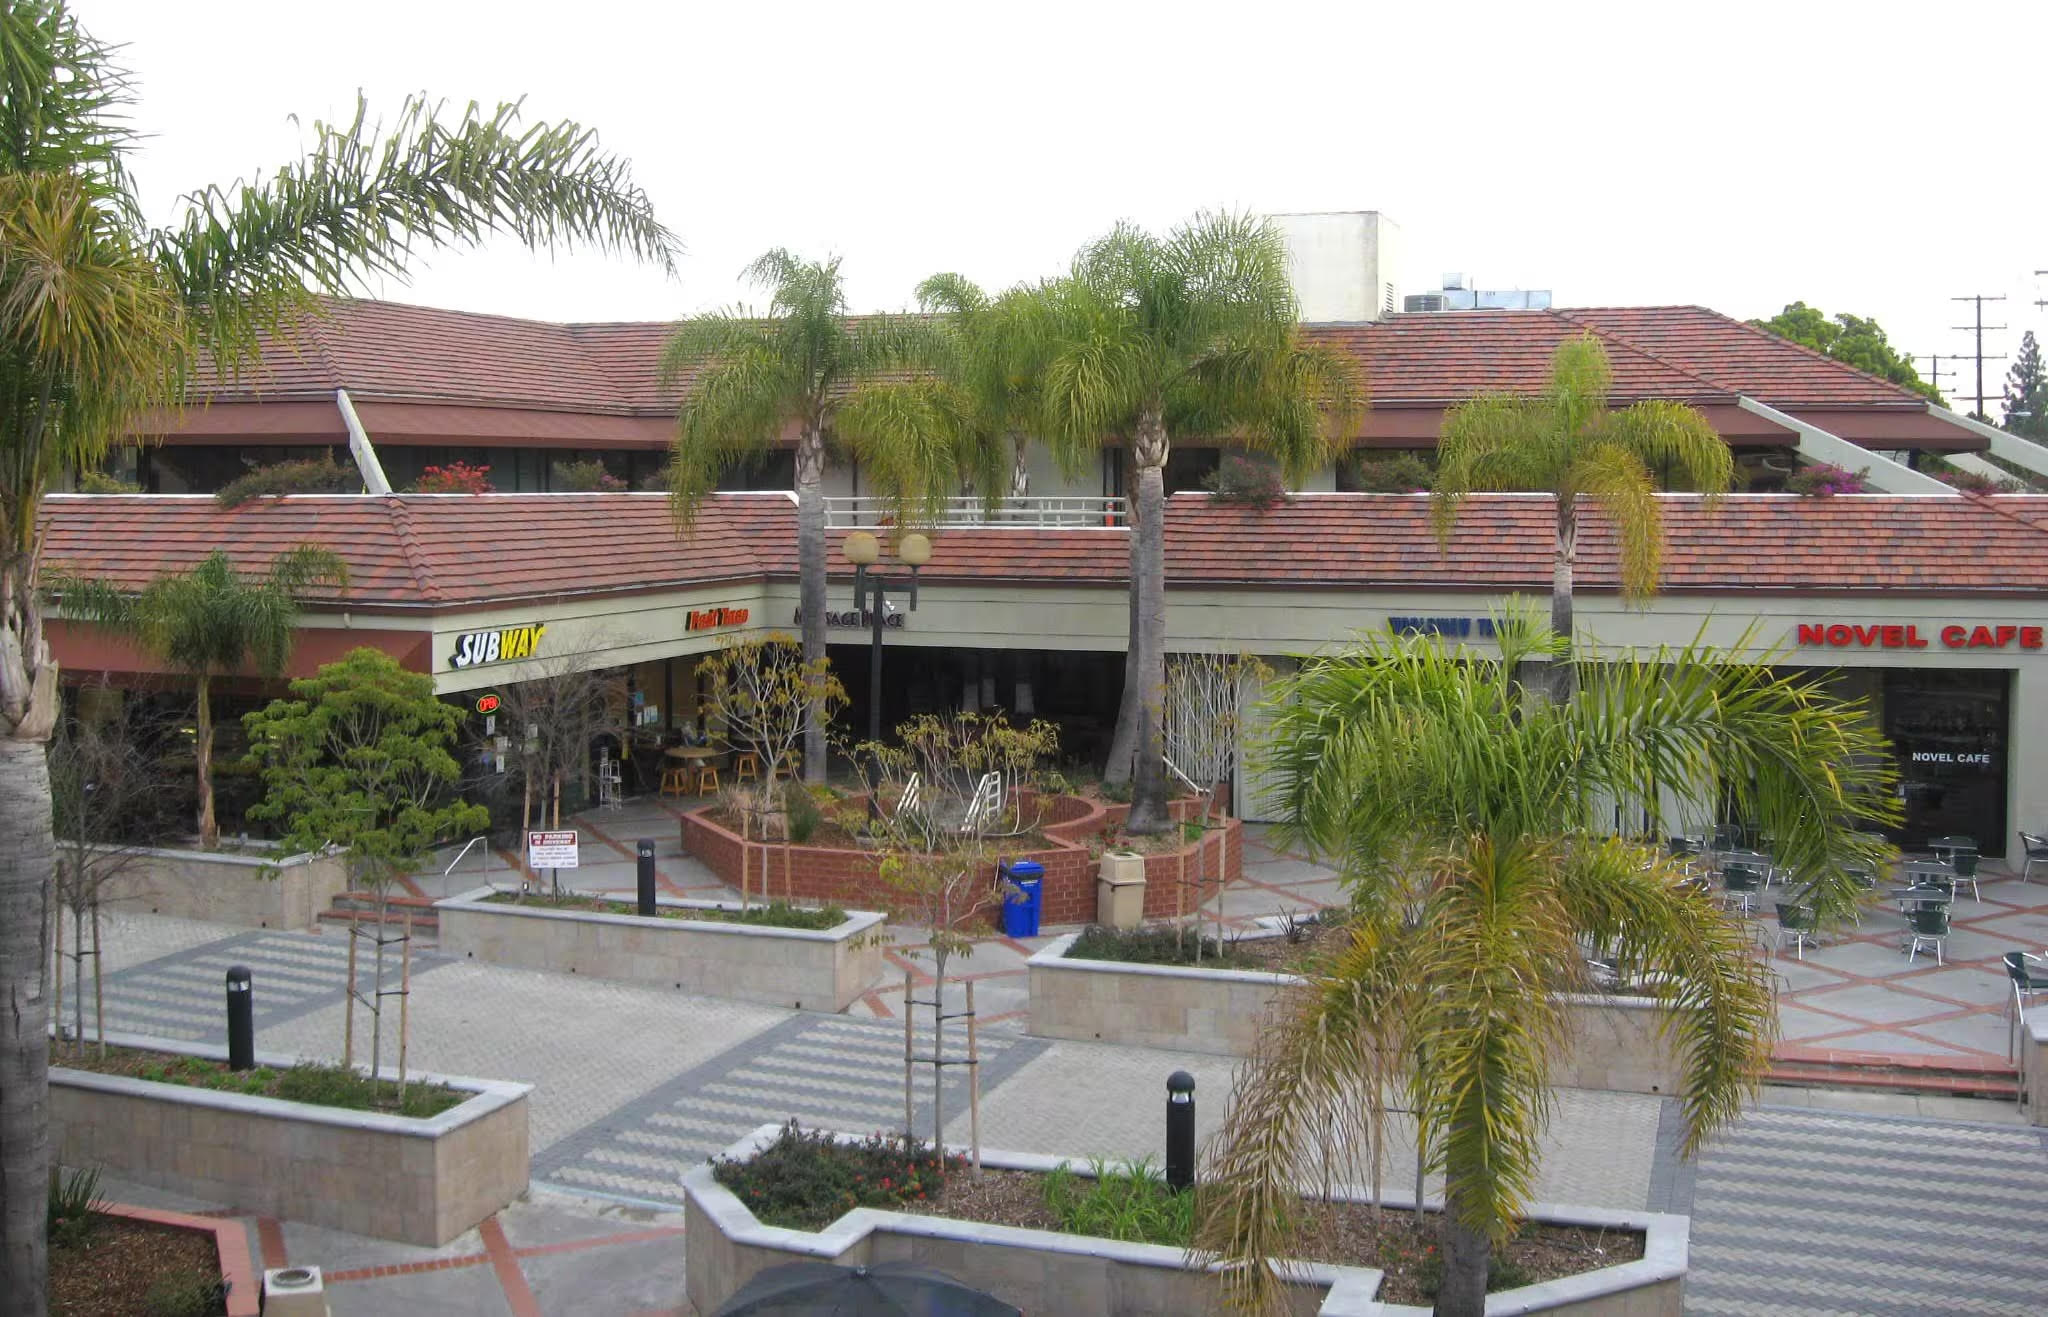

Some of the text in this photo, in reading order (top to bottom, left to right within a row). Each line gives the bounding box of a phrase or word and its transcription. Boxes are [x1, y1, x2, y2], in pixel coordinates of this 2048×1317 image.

[793, 606, 859, 627] MSAGE
[451, 625, 547, 668] SUBWAY
[1798, 623, 2044, 650] NOVEL CAFE
[1912, 752, 1990, 764] NOVEL CAFE
